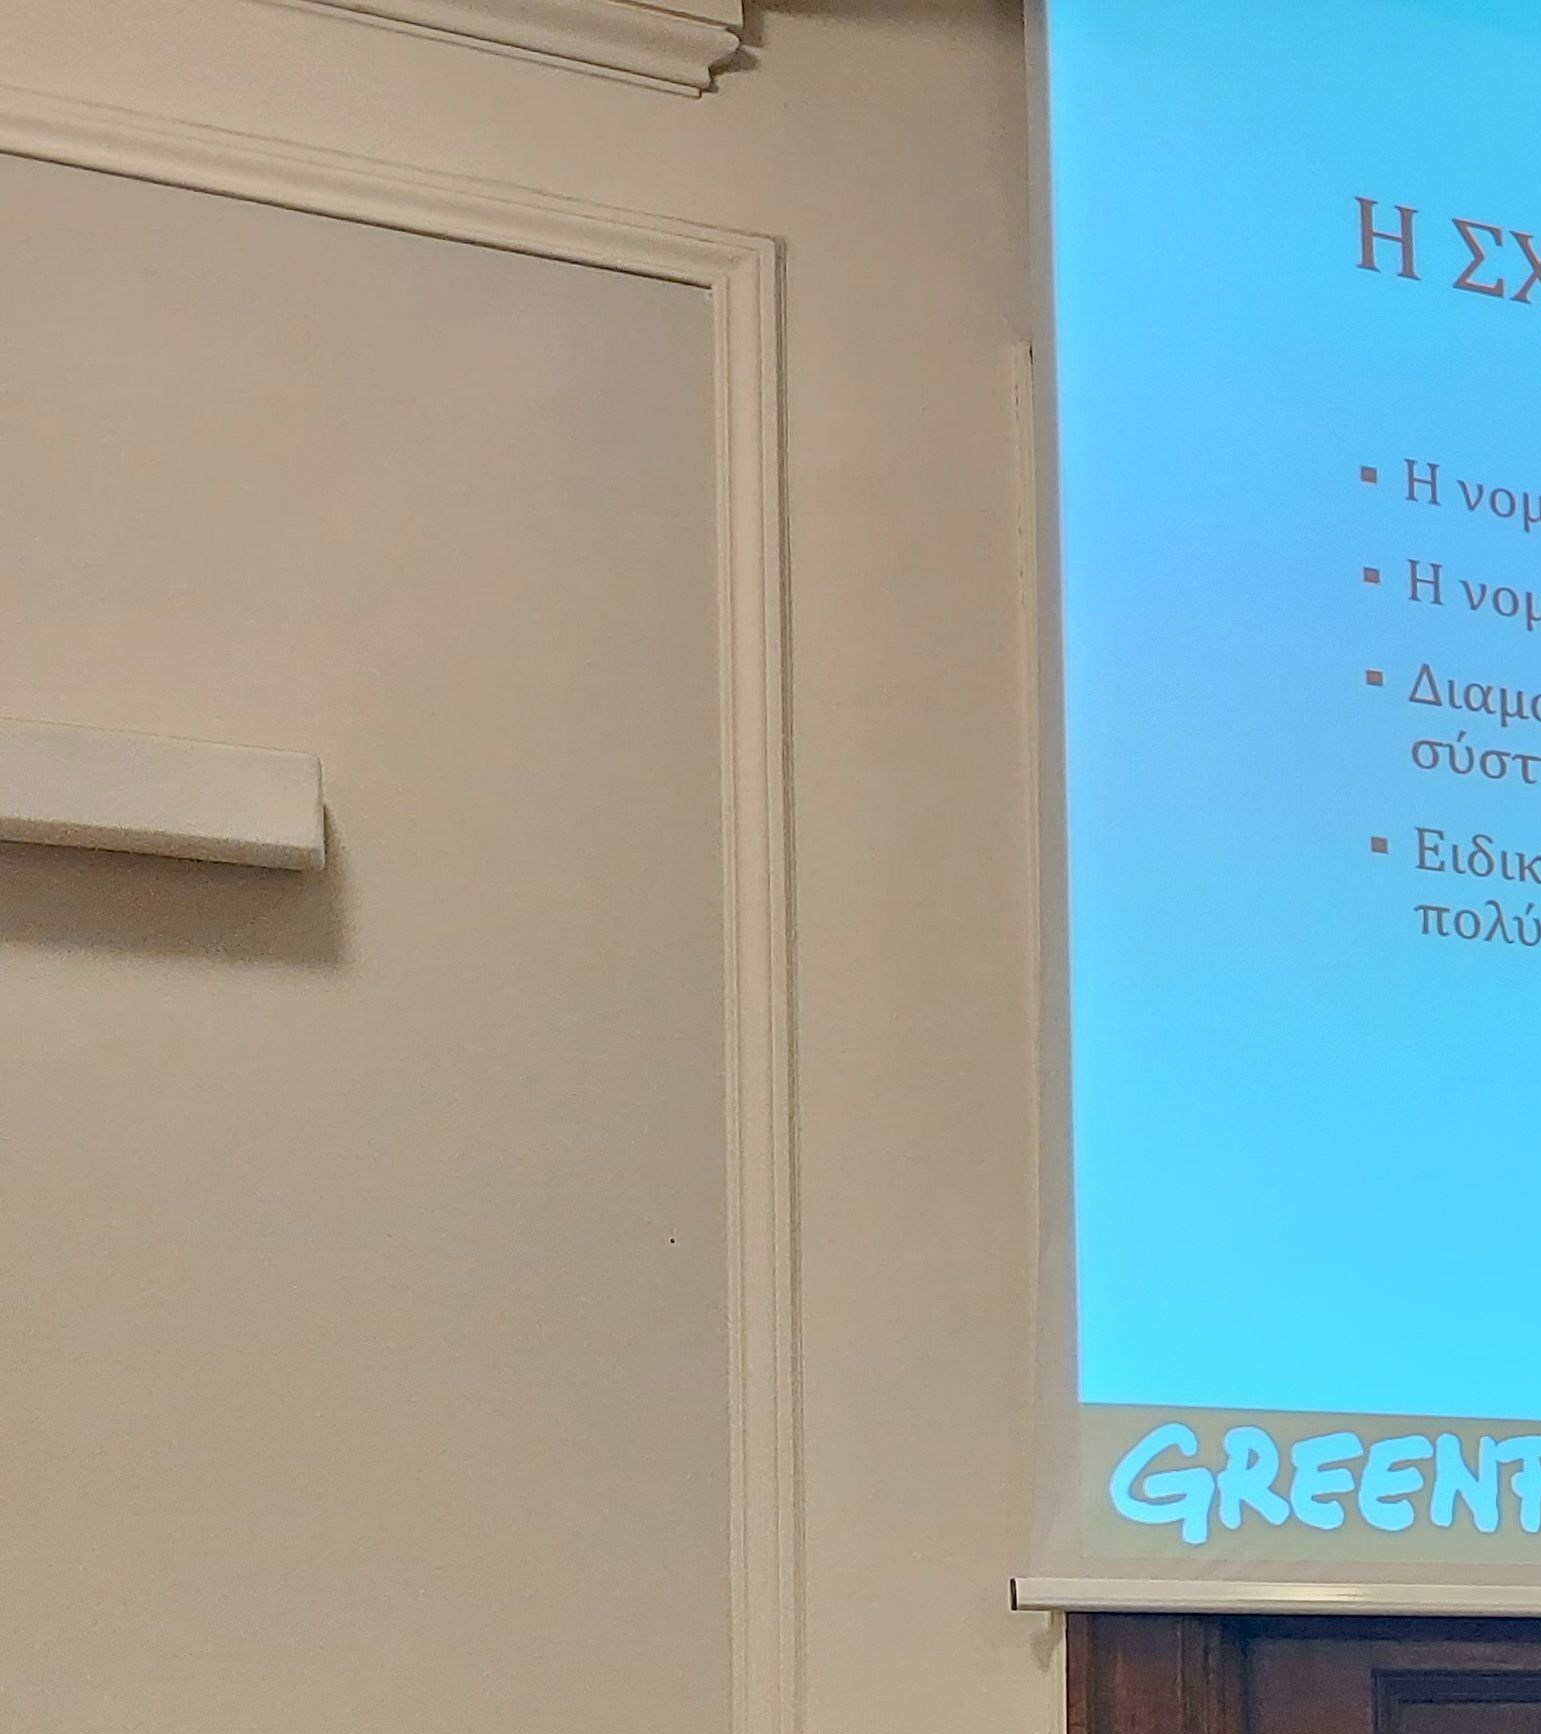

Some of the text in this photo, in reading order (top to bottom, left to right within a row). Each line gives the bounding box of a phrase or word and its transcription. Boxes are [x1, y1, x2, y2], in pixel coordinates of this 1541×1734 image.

[1353, 195, 1422, 282] Η
[1403, 458, 1442, 506] Η
[1407, 558, 1444, 606] Η
